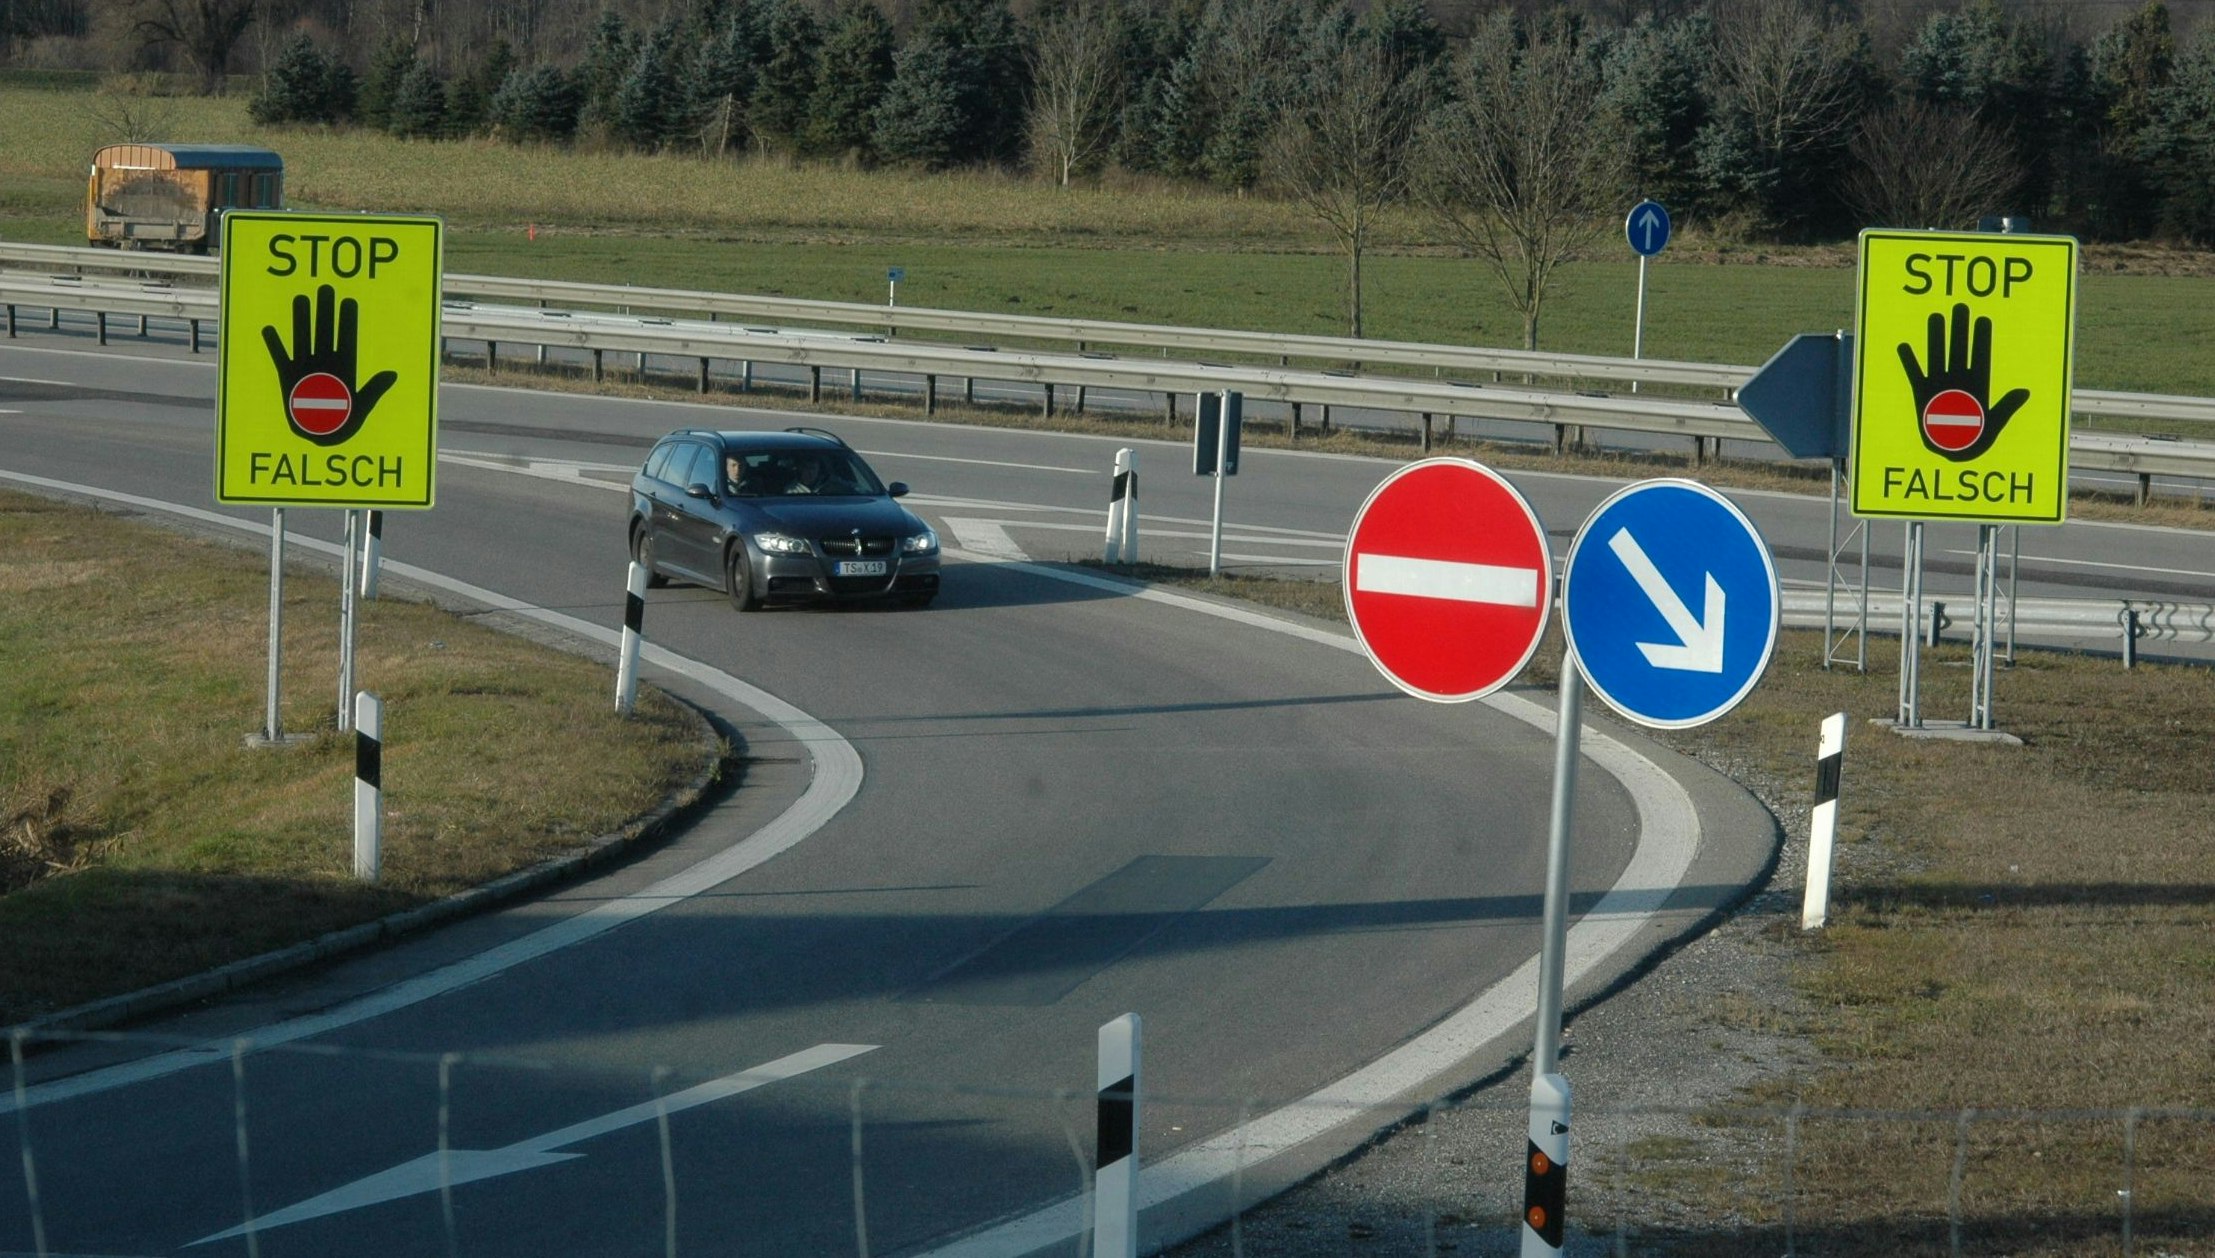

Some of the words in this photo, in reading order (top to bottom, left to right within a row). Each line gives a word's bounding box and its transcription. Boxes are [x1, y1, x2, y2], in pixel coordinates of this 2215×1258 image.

[267, 234, 398, 279] STOP
[1903, 253, 2033, 298] STOP
[250, 453, 402, 488] FALSCH
[1883, 467, 2033, 504] FALSCH
